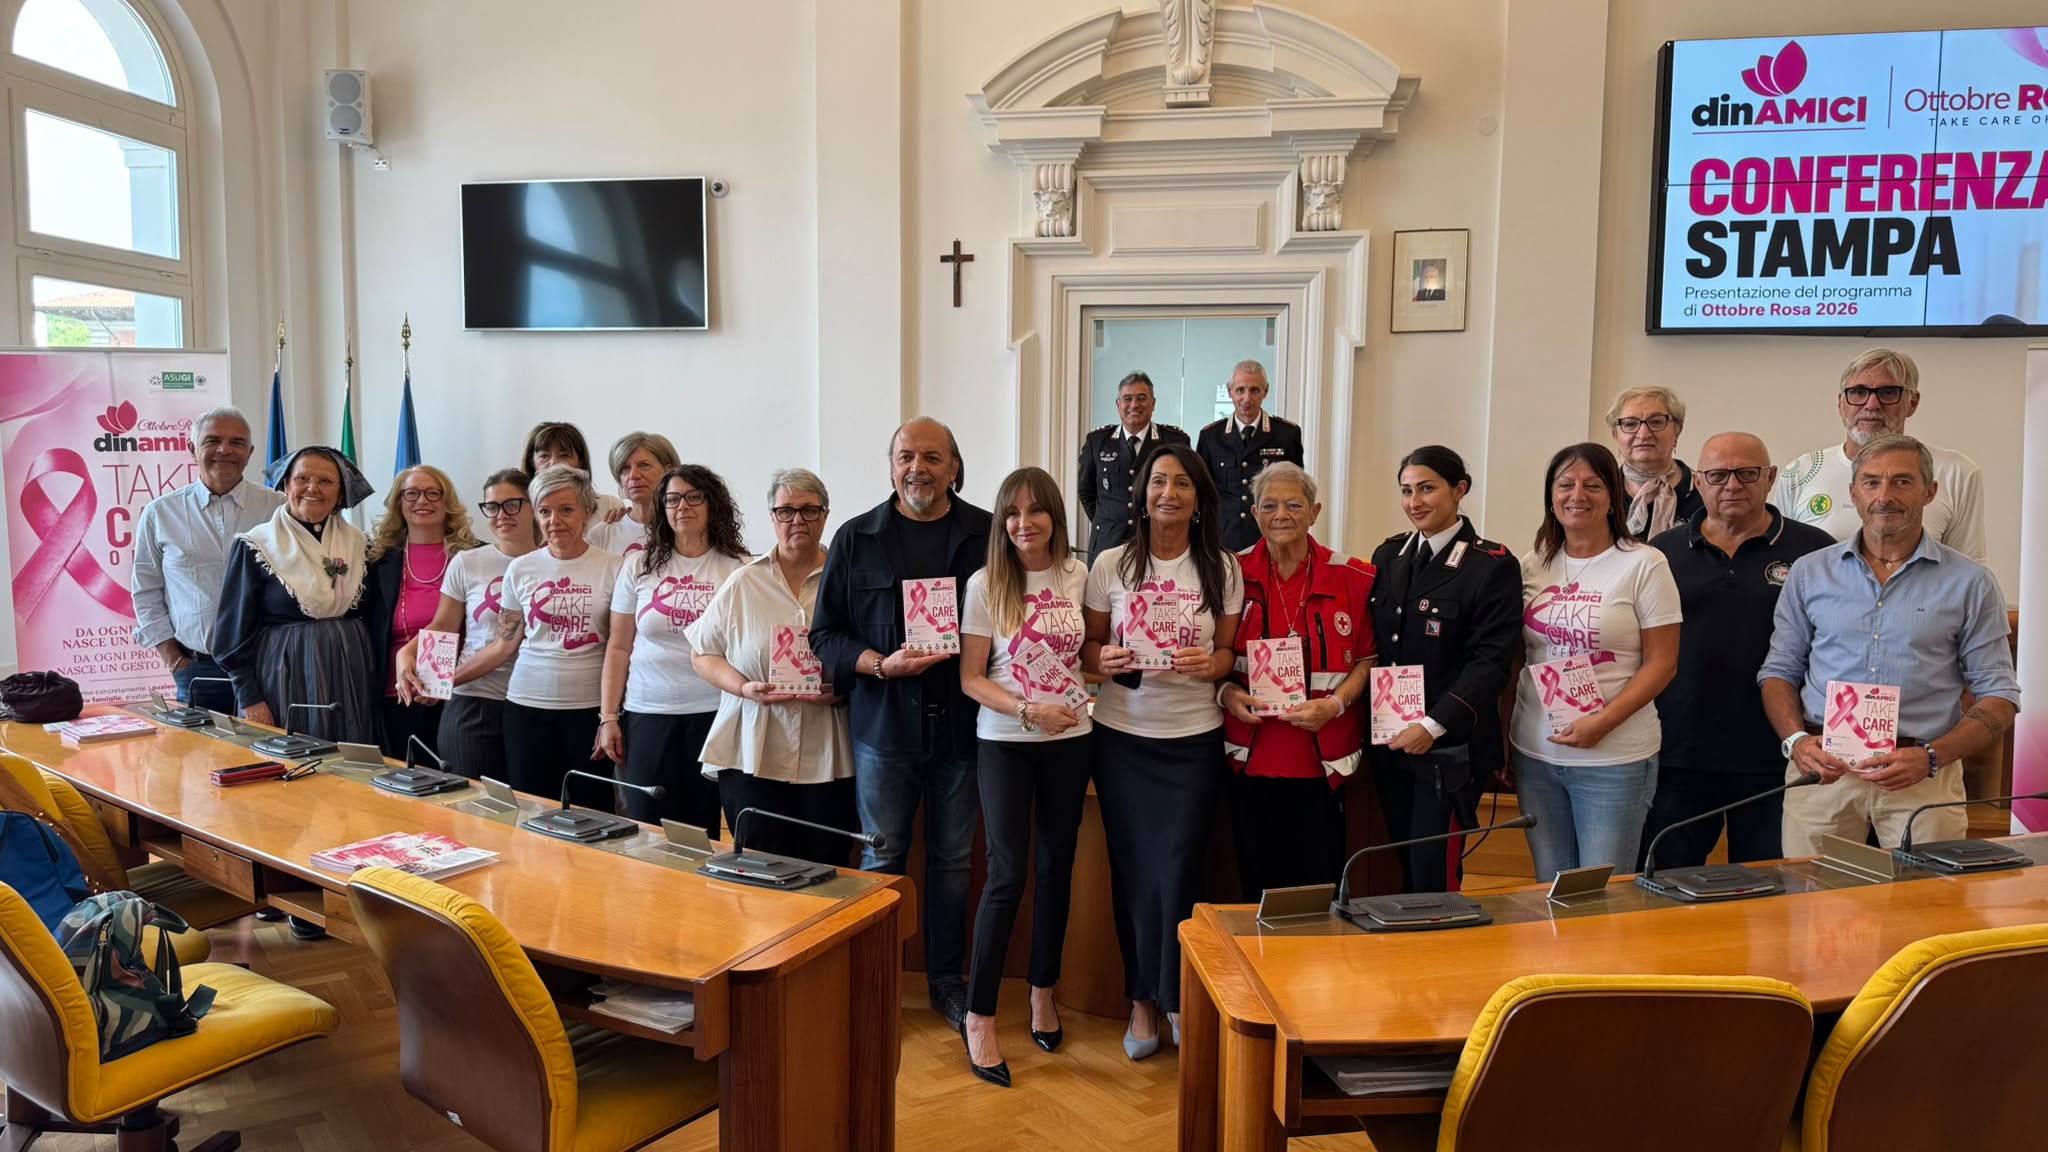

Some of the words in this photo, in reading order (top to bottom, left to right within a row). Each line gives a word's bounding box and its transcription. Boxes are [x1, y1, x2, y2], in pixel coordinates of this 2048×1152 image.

[1904, 86, 2011, 112] Ottobre
[2018, 84, 2048, 111] R
[1691, 93, 1867, 127] dinAMICI
[1929, 117, 1969, 127] TAKE
[1979, 115, 2021, 126] CARE
[1685, 216, 1961, 279] STAMPA
[1685, 286, 1790, 299] Presentazione
[1794, 285, 1818, 298] del
[1822, 286, 1912, 301] programma
[1684, 304, 1697, 317] di
[1701, 303, 1765, 317] Ottobre
[1770, 303, 1811, 316] Rosa
[1816, 302, 1858, 316] 2026
[164, 373, 191, 382] ASUGI
[549, 596, 592, 615] TAKE
[1551, 593, 1603, 603] dinAMICI
[932, 606, 955, 617] CARE
[1152, 608, 1176, 621] TAKE
[1549, 603, 1601, 630] TAKE
[551, 615, 591, 633] CARE
[1038, 610, 1082, 635] TAKE
[1152, 621, 1177, 633] CARE
[76, 628, 94, 638] DA
[98, 625, 133, 636] OGNI
[1180, 626, 1202, 647] RE
[1546, 625, 1600, 650] CARE
[62, 637, 107, 649] NASCE
[111, 636, 129, 646] UN
[73, 654, 91, 664] DA
[94, 651, 126, 662] OGNI
[436, 656, 453, 667] CARE
[57, 665, 97, 676] NASCE
[101, 663, 117, 673] UN
[121, 660, 160, 672] GESTO
[1040, 665, 1063, 684] CARE
[1278, 666, 1301, 677] CARE
[1564, 669, 1592, 686] TAKE
[1570, 683, 1597, 698] CARE
[1398, 694, 1422, 705] CARE
[1864, 701, 1895, 719] TAKE
[1863, 717, 1893, 732] CARE
